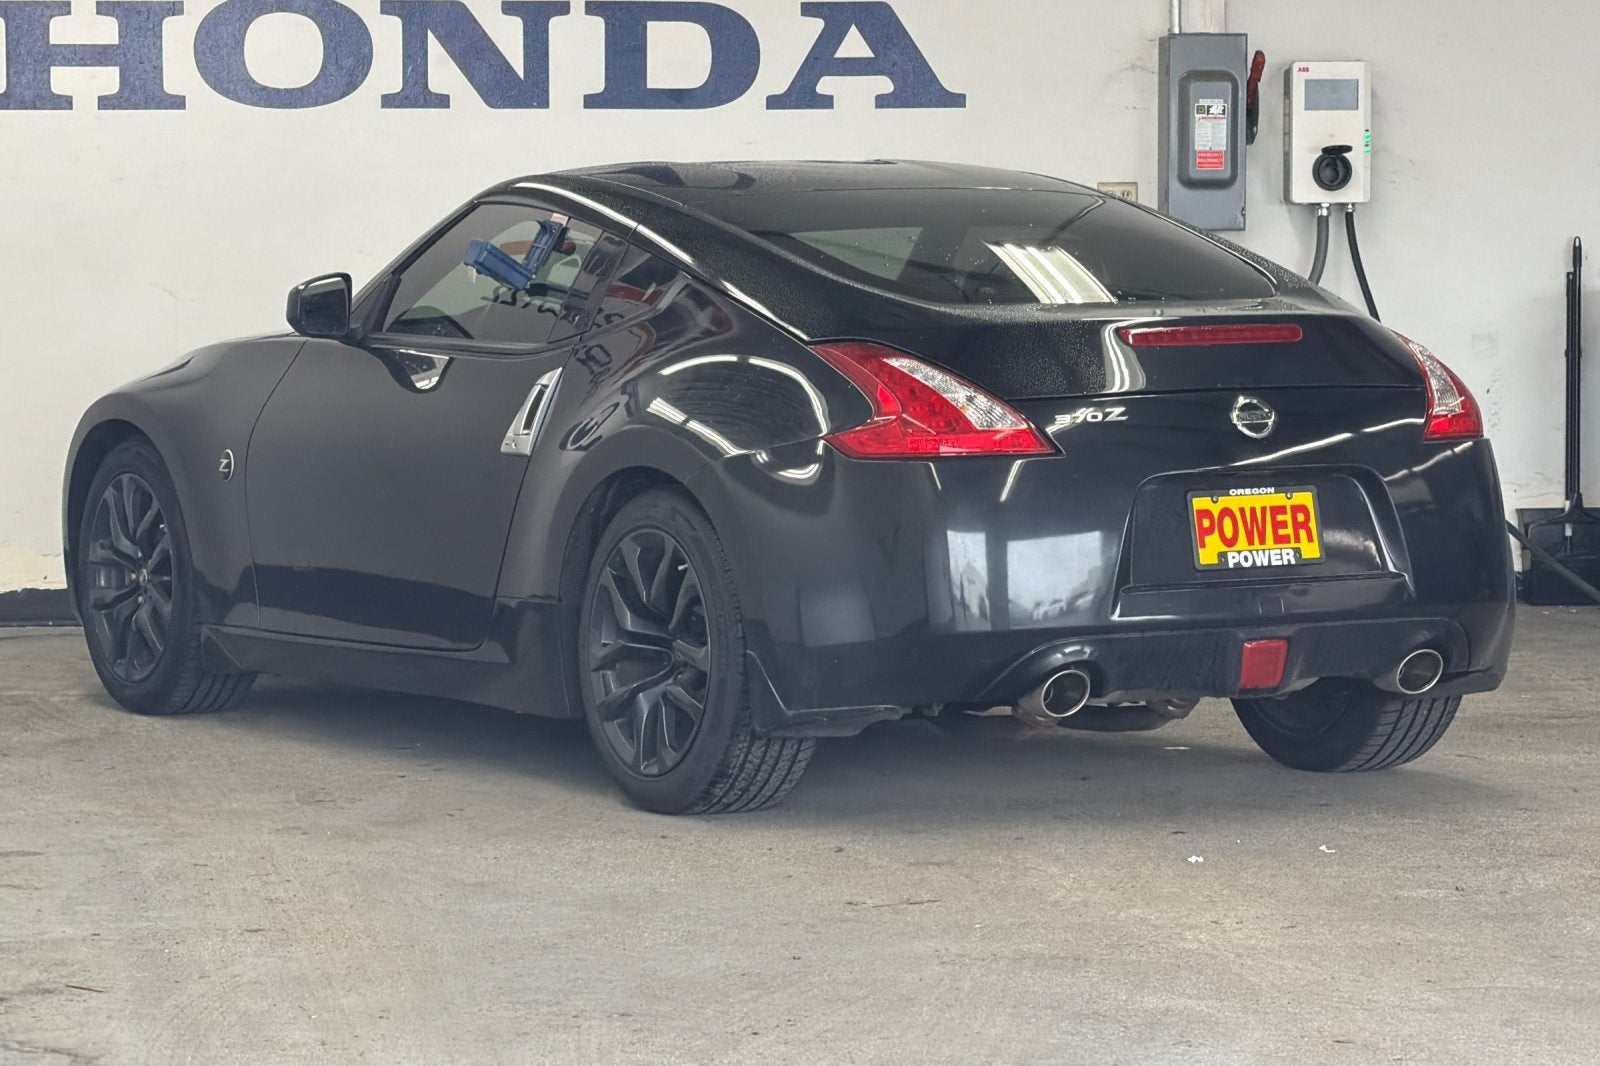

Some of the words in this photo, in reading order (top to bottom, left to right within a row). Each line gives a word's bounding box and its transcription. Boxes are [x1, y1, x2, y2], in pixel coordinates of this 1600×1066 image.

[0, 1, 966, 110] HONDA
[1229, 487, 1275, 496] OREGON
[1195, 504, 1314, 549] POWER
[1227, 548, 1296, 568] POWER
